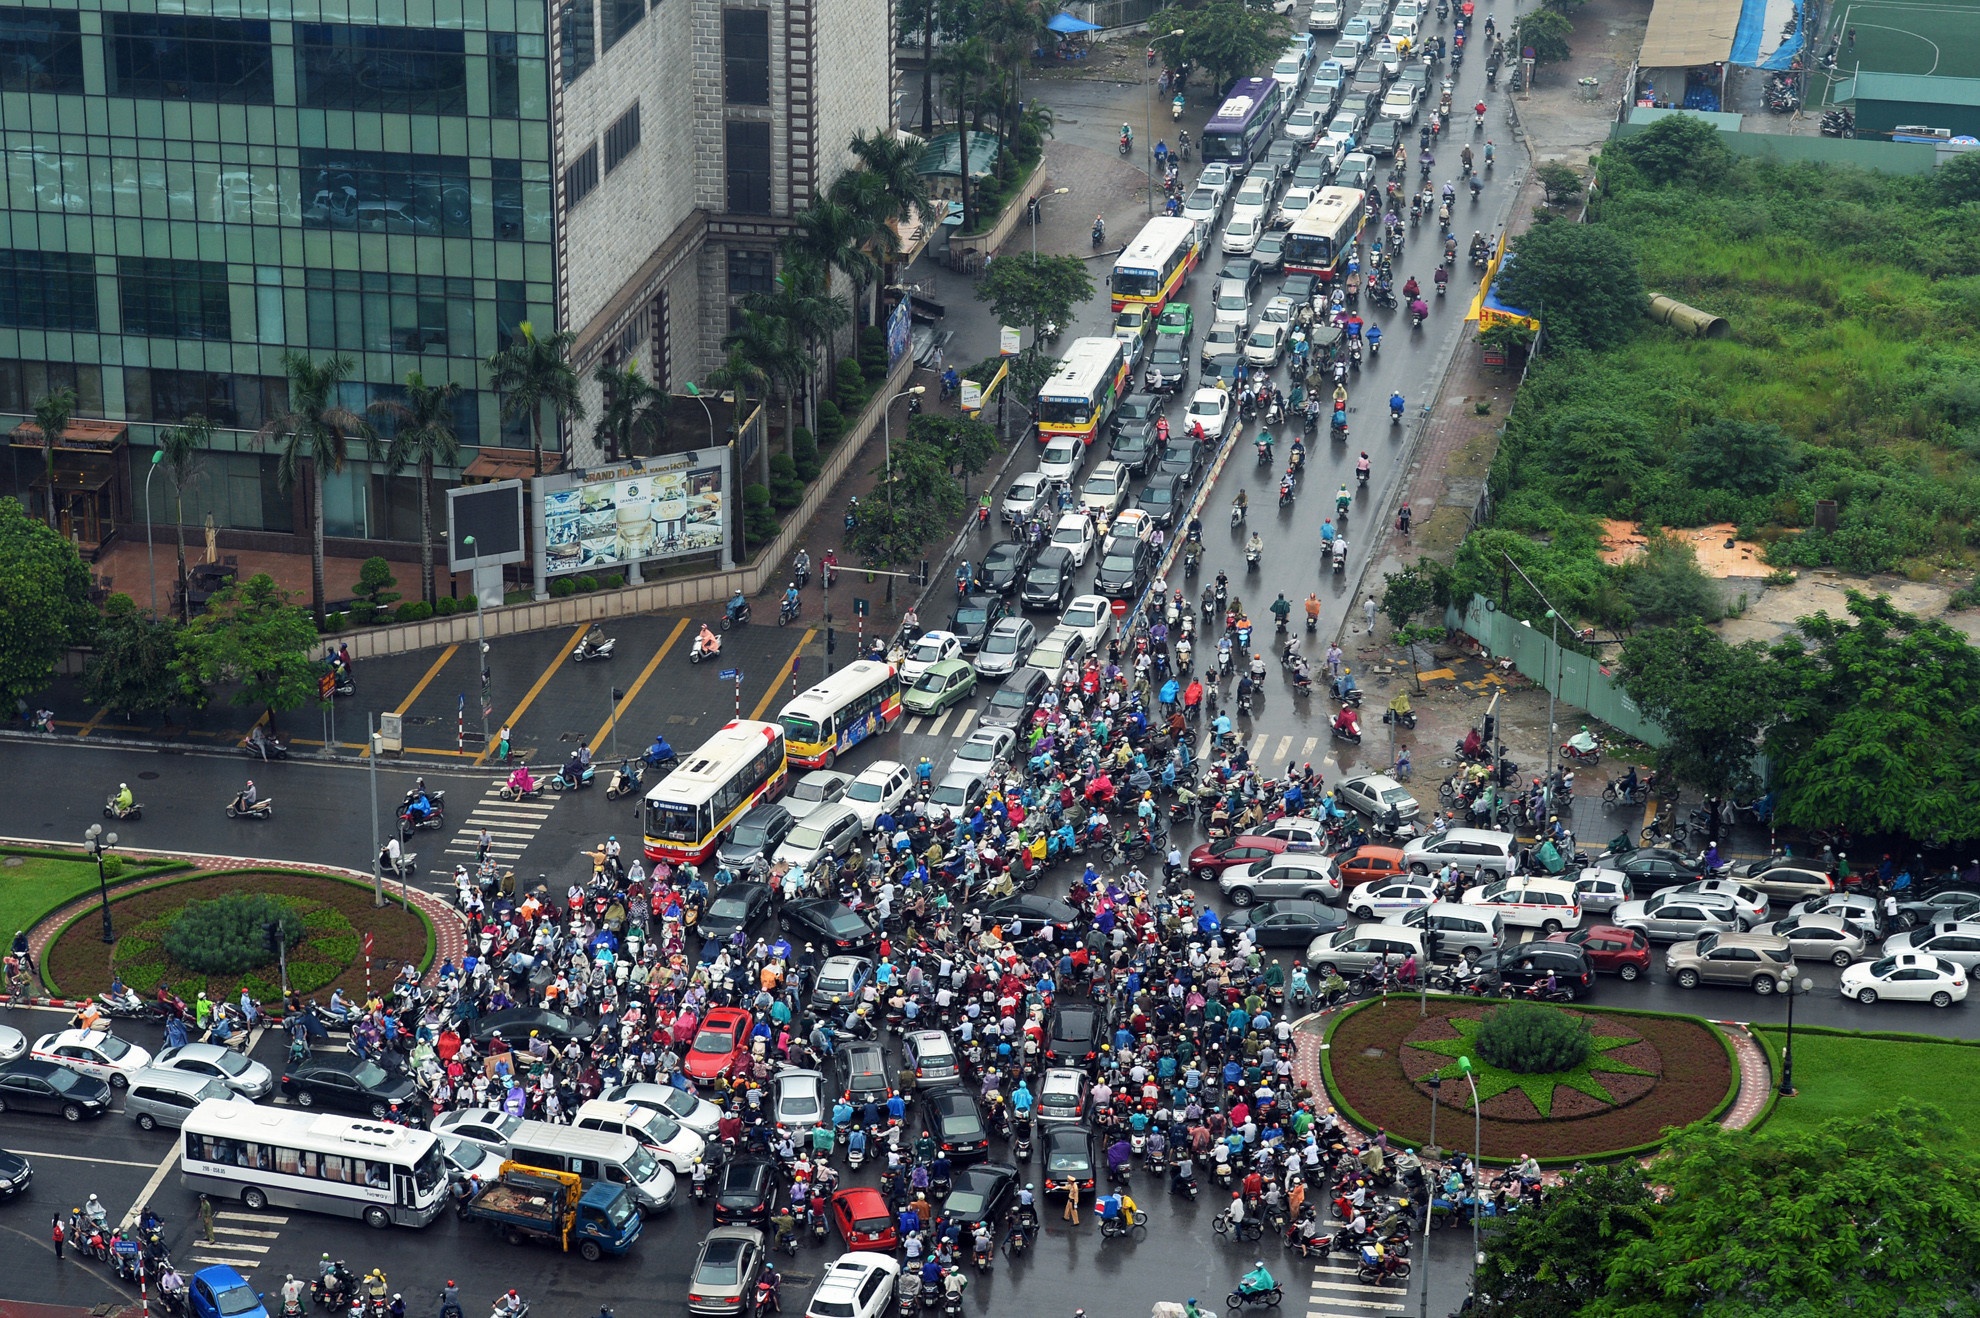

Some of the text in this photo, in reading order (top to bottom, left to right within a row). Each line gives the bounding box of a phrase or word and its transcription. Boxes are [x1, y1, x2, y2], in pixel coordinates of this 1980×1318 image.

[582, 470, 615, 483] GRAND
[617, 466, 647, 478] PLAZA
[670, 460, 696, 470] HOTEL
